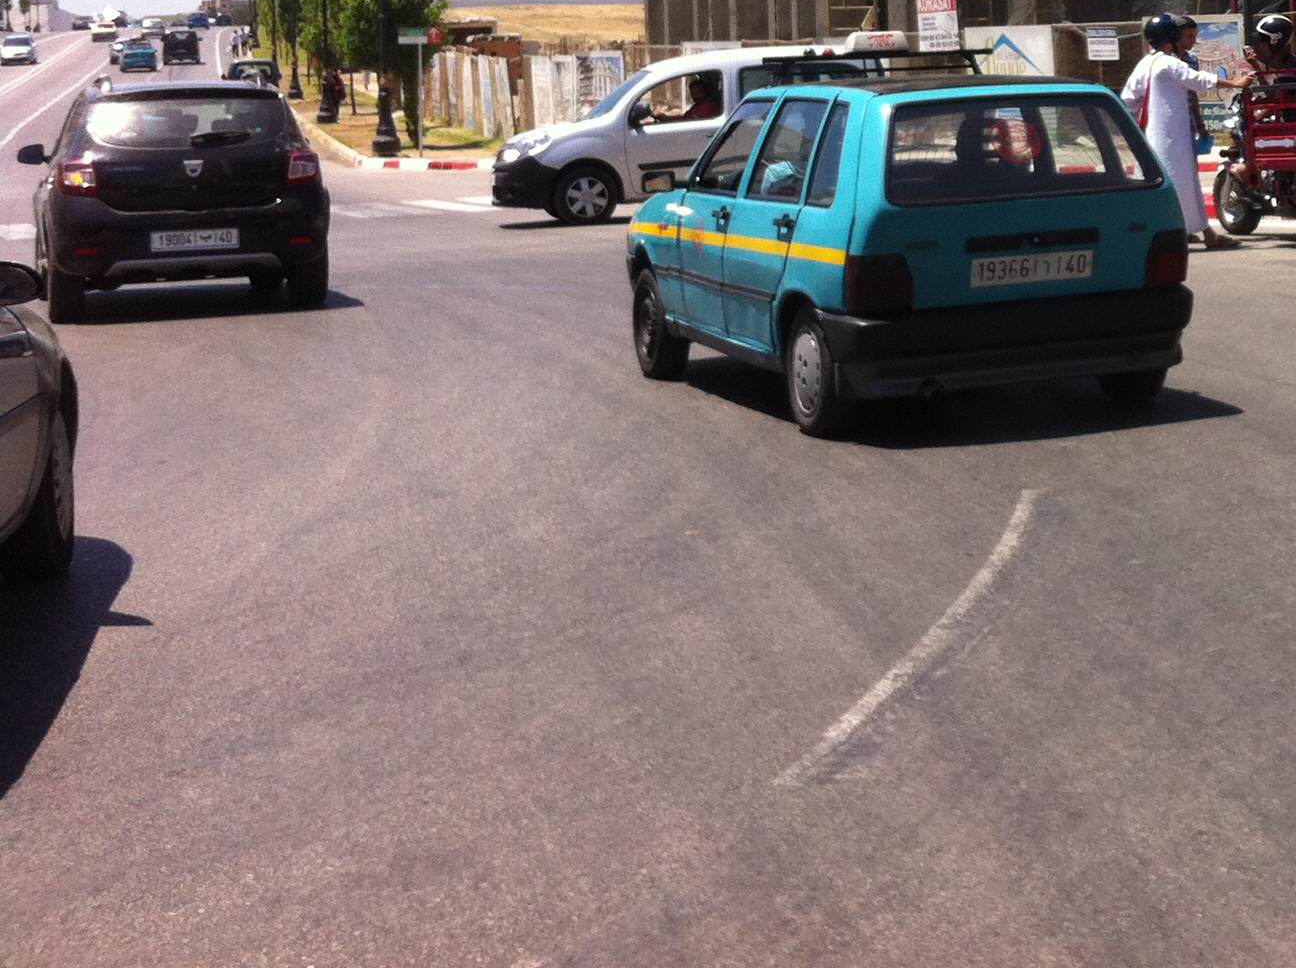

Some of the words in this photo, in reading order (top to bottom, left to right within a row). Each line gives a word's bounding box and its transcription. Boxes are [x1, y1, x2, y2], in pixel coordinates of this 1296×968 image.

[219, 230, 232, 244] 40
[977, 257, 1030, 282] 19366
[1065, 253, 1087, 274] 40
